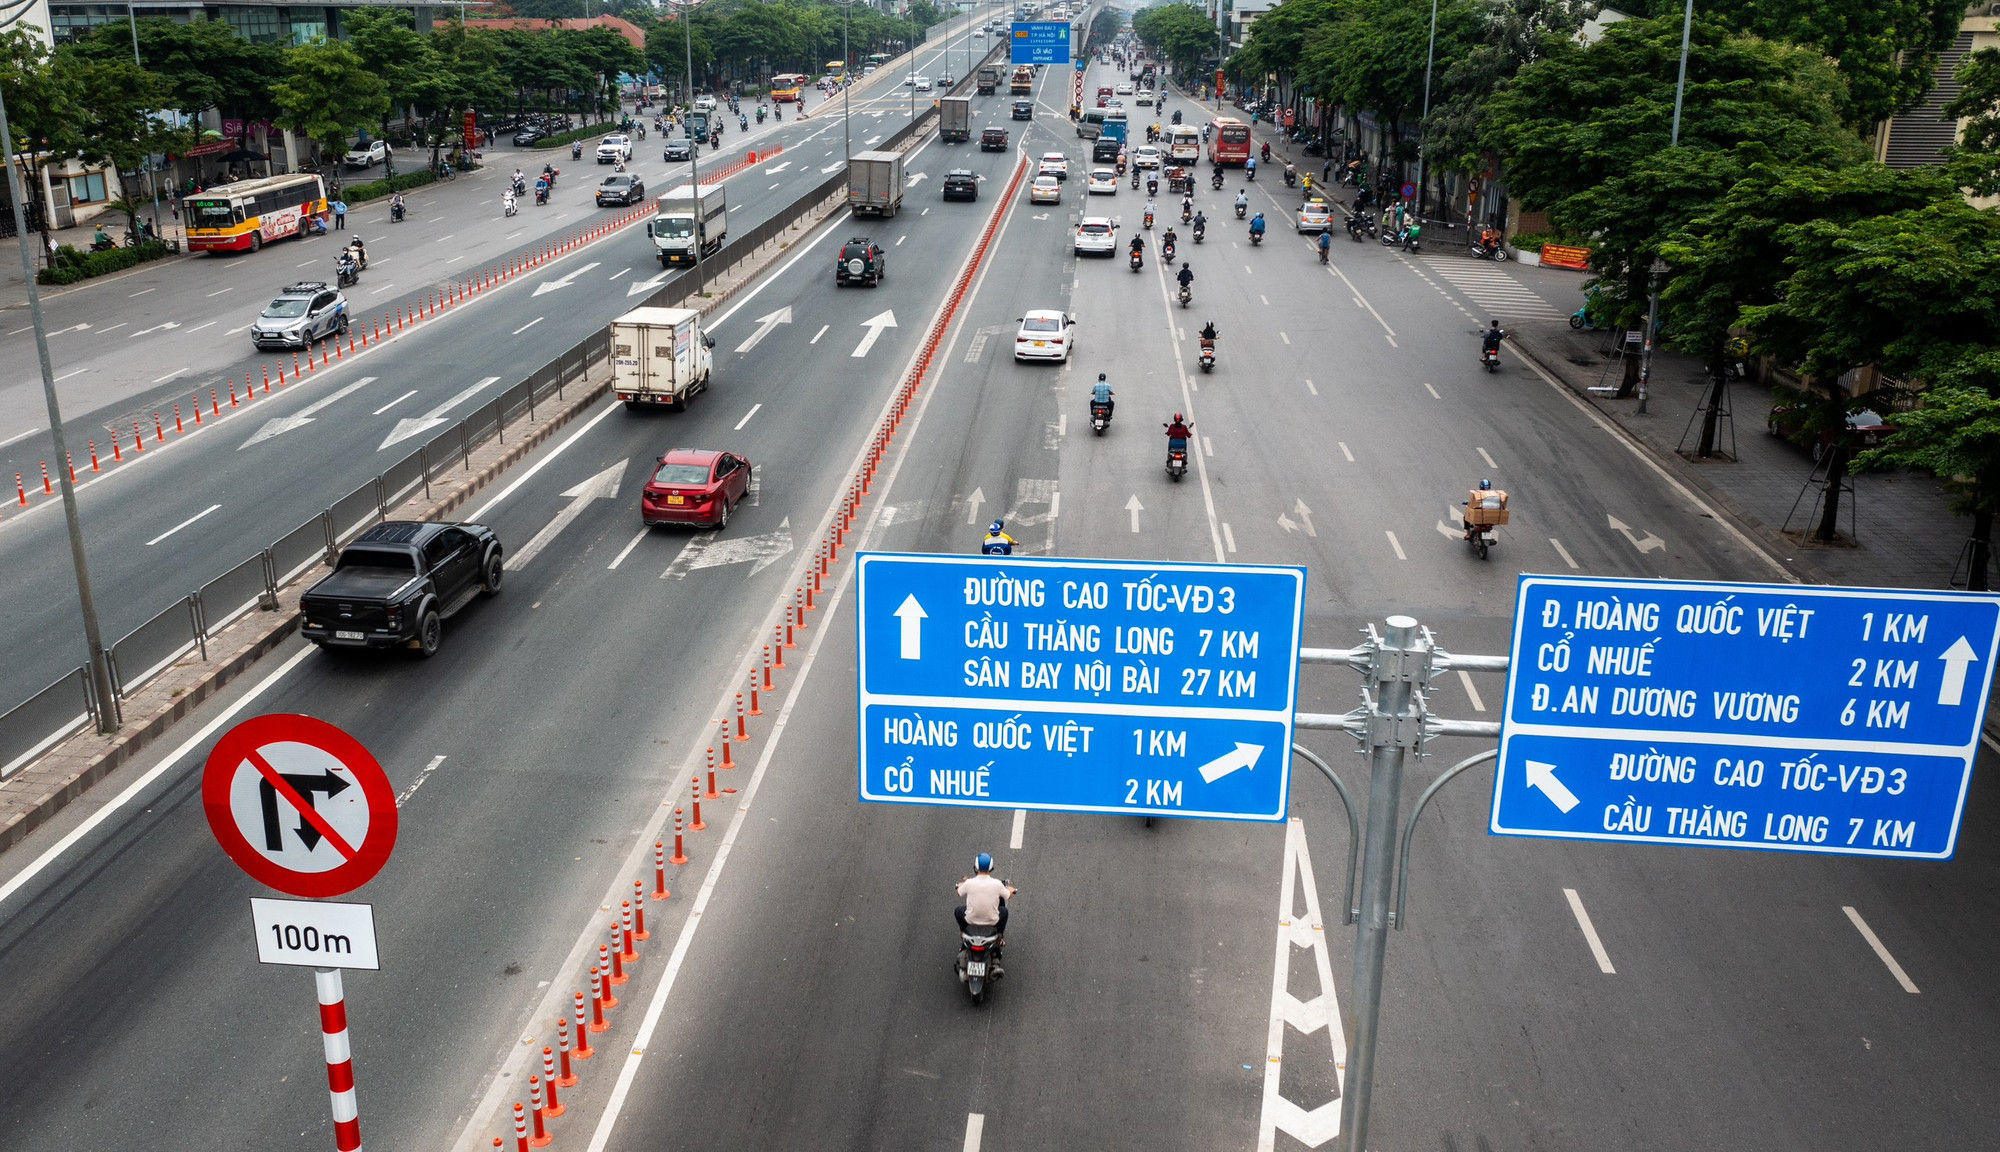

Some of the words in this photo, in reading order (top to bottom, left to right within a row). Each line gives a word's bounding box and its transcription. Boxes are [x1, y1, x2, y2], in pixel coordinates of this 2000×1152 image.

[963, 571, 1045, 608] ĐƯỜNG
[1063, 580, 1109, 610] CAO
[964, 611, 1008, 649] CẦU
[1023, 619, 1101, 653] THĂNG
[1115, 626, 1174, 656] LONG
[1199, 629, 1213, 657] 7
[1221, 630, 1259, 659] KM
[1676, 594, 1744, 635] QUỐC
[1758, 603, 1815, 644] VIỆT
[1862, 612, 1874, 642] 1
[1882, 613, 1929, 644] KM
[964, 655, 1010, 688] SÂN
[1021, 661, 1063, 690] BAY
[1074, 659, 1111, 697] NỘI
[1122, 659, 1160, 694] BÀI
[1180, 668, 1211, 696] 27
[1218, 669, 1257, 698] KM
[1537, 631, 1575, 673] CỔ
[1587, 636, 1662, 677] NHUẾ
[1848, 658, 1867, 687] 2
[1873, 659, 1919, 689] KM
[1611, 686, 1697, 718] DƯƠNG
[1713, 691, 1800, 724] VƯƠNG
[1840, 698, 1857, 726] 6
[1866, 699, 1910, 729] KM
[884, 712, 958, 748] HOÀNG
[973, 713, 1032, 750] QUỐC
[1042, 719, 1094, 758] VIỆT
[1133, 729, 1143, 756] 1
[1149, 729, 1187, 758] KM
[884, 755, 914, 793] CỔ
[930, 760, 995, 797] NHUẾ
[1124, 778, 1139, 804] 2
[1146, 779, 1183, 807] KM
[1609, 747, 1697, 784] ĐƯỜNG
[1713, 758, 1765, 788] CAO
[1603, 795, 1652, 833] CẦU
[1666, 804, 1748, 838] THĂNG
[1763, 813, 1829, 843] LONG
[1847, 818, 1864, 845] 7
[1872, 819, 1916, 848] KM
